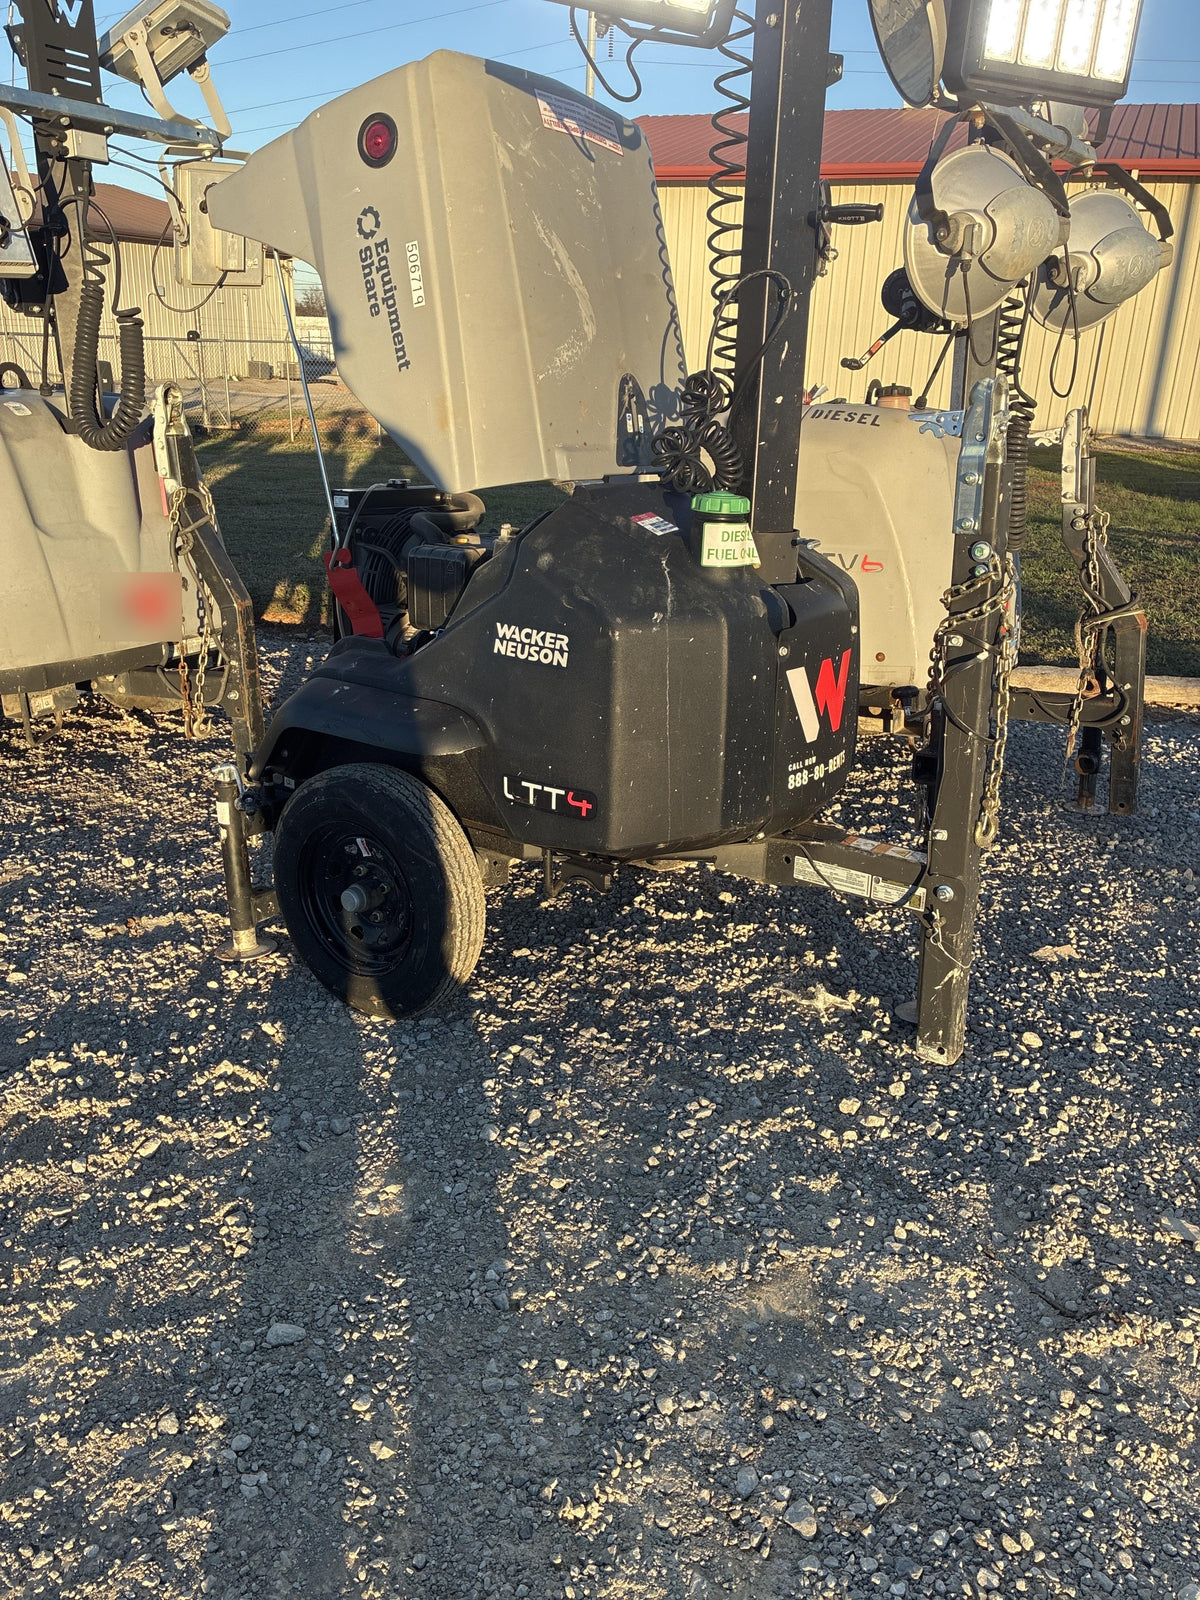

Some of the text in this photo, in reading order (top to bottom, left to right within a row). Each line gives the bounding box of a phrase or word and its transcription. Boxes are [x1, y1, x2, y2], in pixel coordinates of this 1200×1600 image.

[359, 245, 381, 318] Share
[406, 243, 424, 305] 506719
[374, 237, 411, 372] Equipment
[810, 409, 881, 427] DIESEL
[721, 530, 753, 542] DIESL
[707, 547, 758, 560] FUEL ONL
[496, 622, 569, 652] WACKER
[493, 639, 569, 668] NEUSON
[785, 648, 851, 744] W
[788, 756, 817, 772] CALL NOW
[503, 776, 593, 817] LTT4
